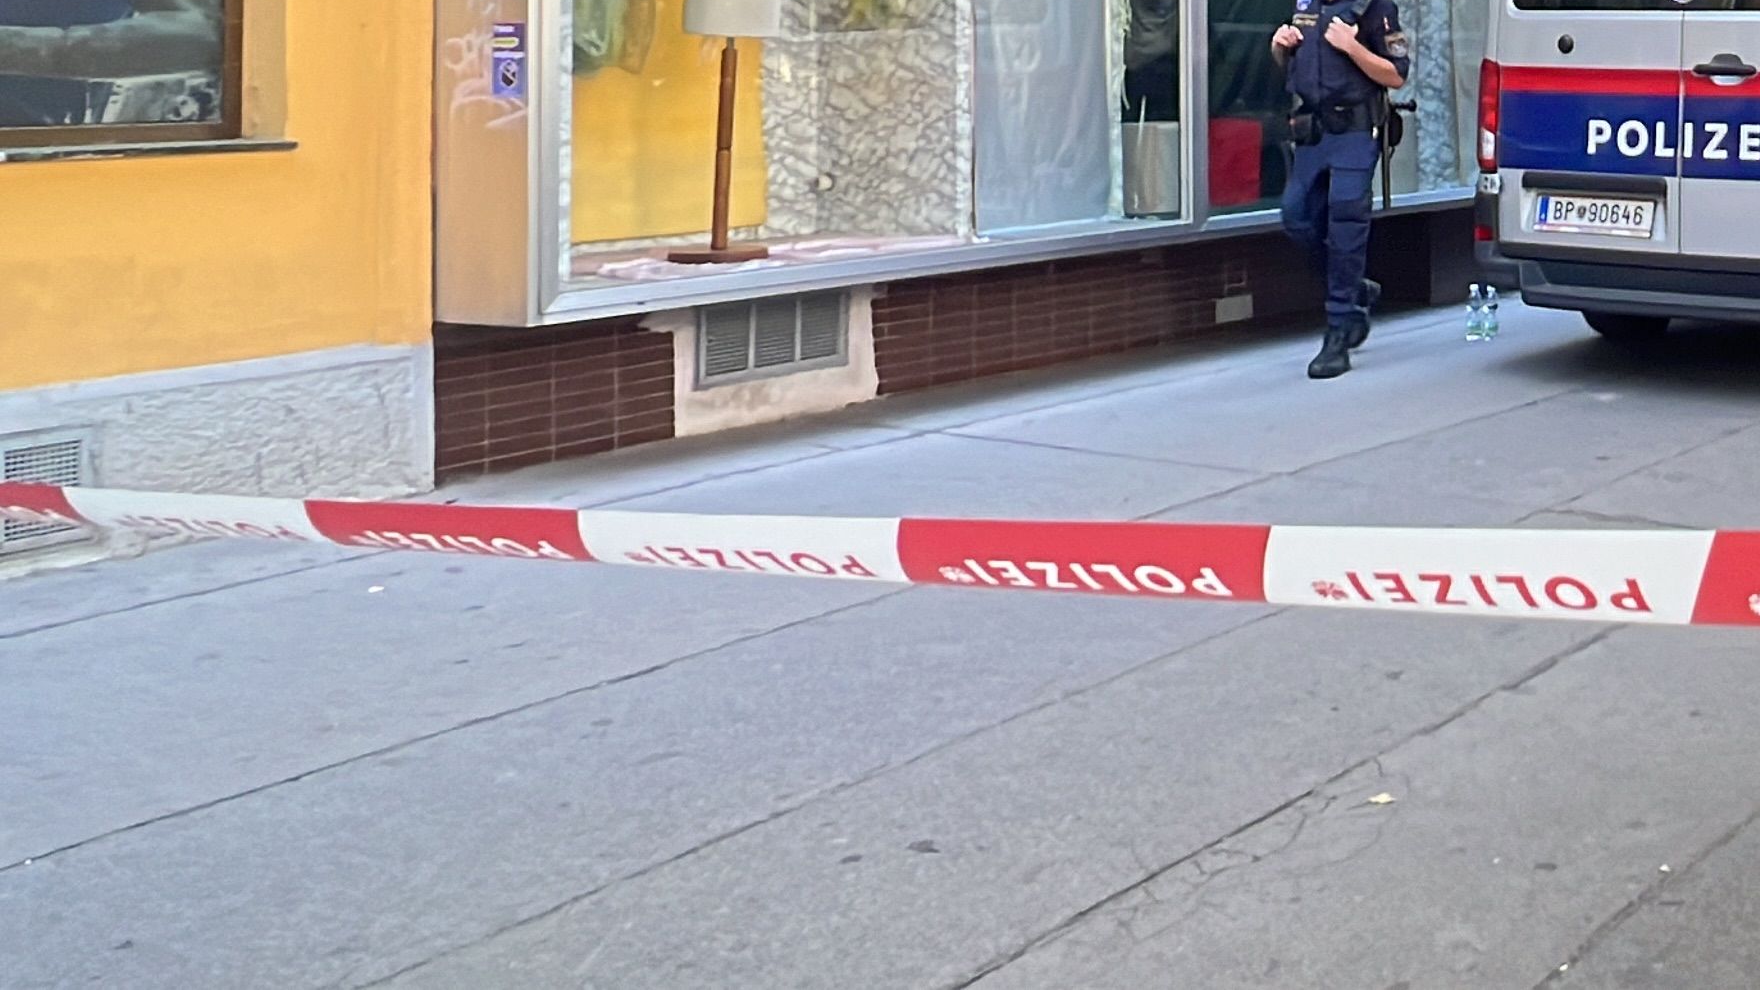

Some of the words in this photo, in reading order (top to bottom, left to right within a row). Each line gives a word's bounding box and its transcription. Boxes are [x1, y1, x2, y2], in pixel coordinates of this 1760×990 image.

[1553, 200, 1575, 221] BP
[1588, 203, 1644, 226] 90646
[644, 545, 878, 578] POLIZEI
[974, 558, 1233, 598] POLIZEI
[1343, 571, 1653, 614] POLIZEI
